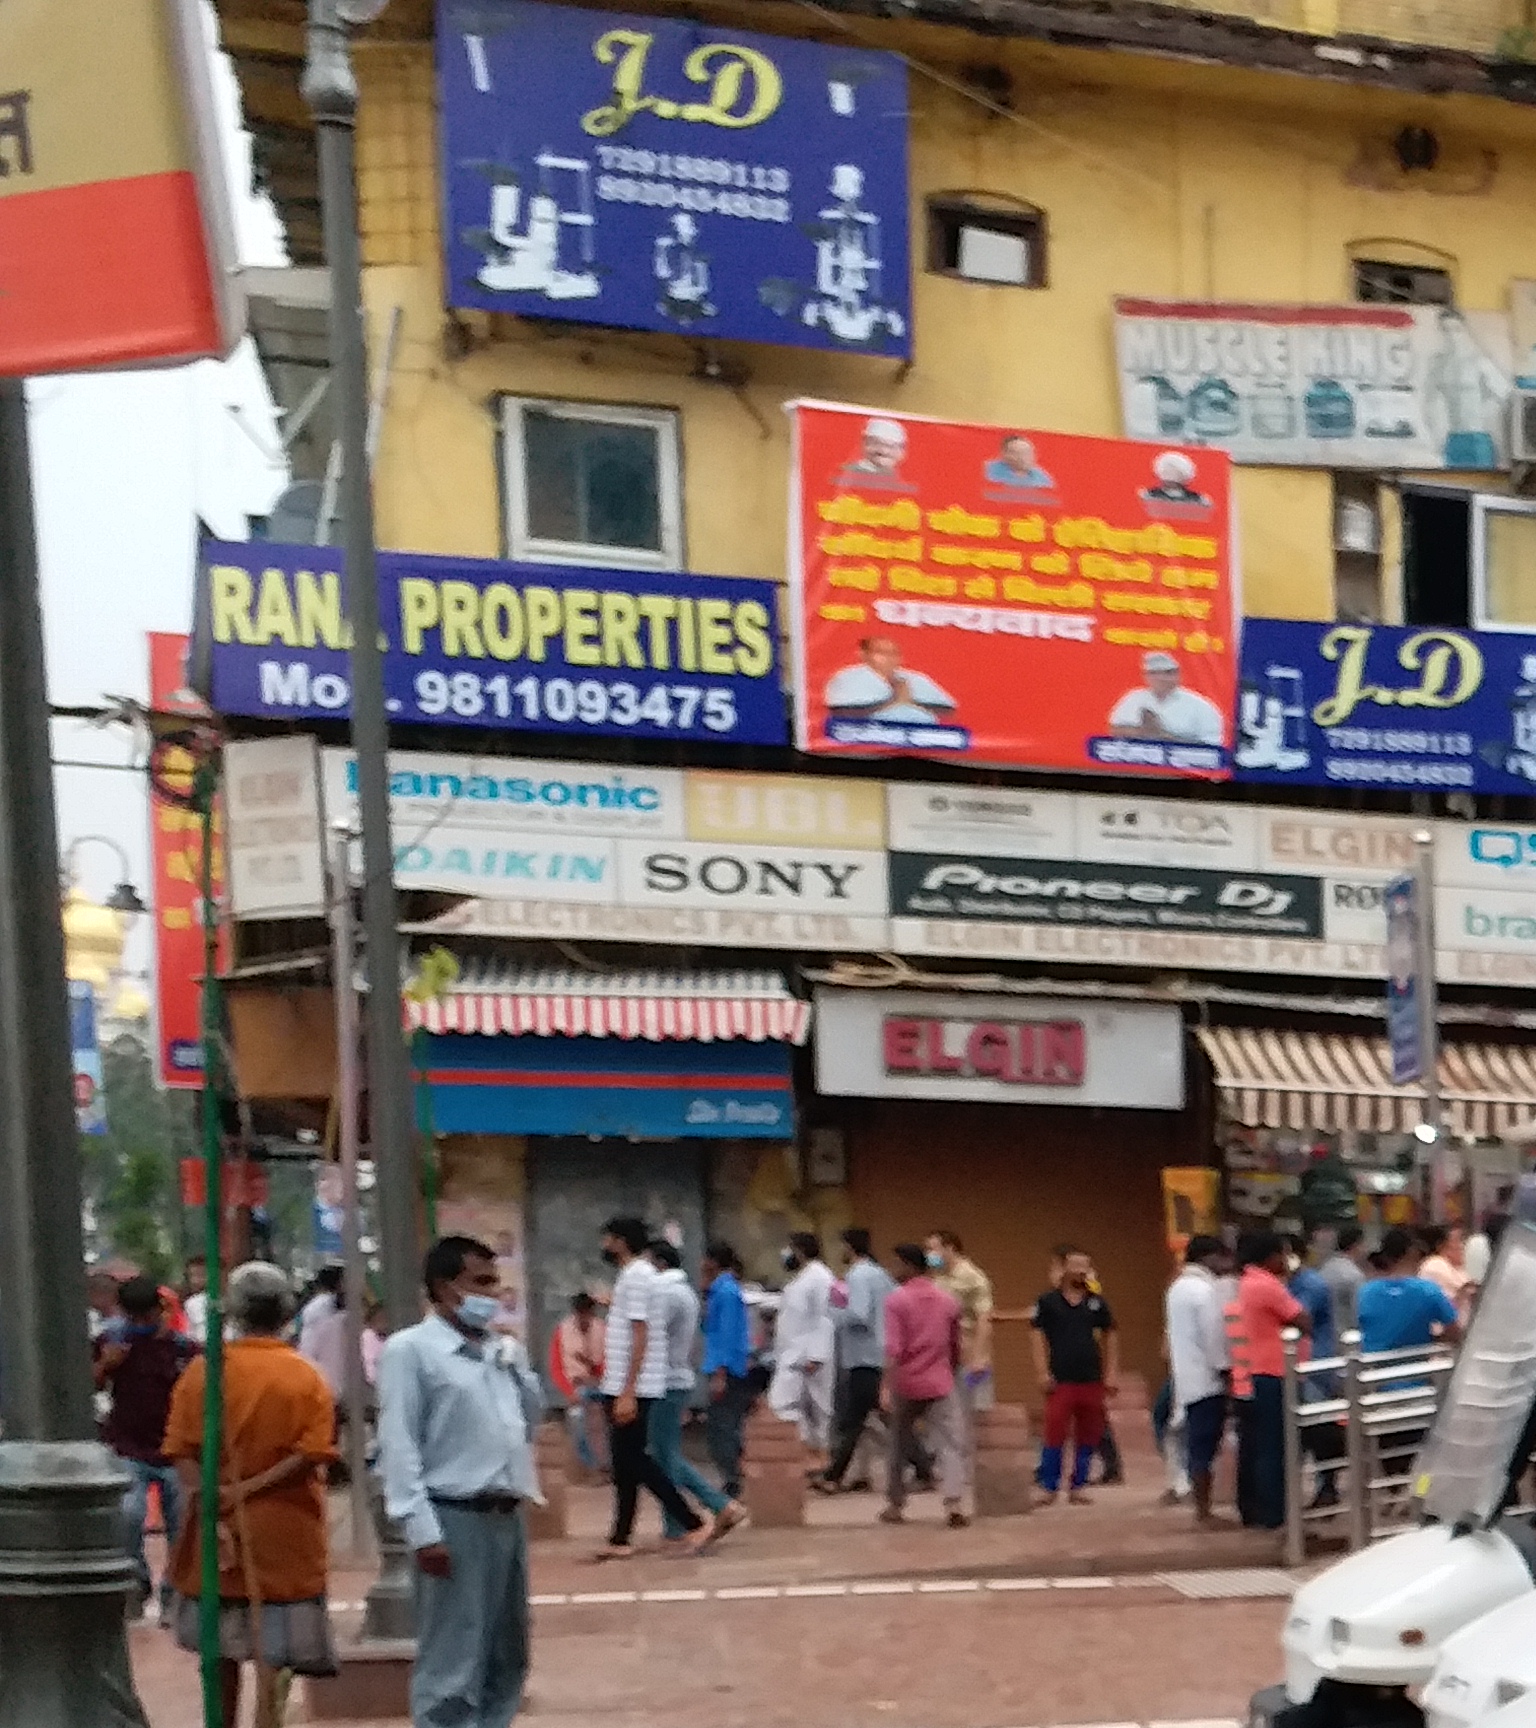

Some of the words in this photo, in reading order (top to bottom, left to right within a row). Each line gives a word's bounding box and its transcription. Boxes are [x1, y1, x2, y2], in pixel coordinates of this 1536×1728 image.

[582, 28, 784, 137] J.D
[400, 577, 774, 678] PROPERTIES
[258, 660, 402, 712] Mo.
[413, 669, 738, 733] 9811093475
[1311, 625, 1485, 727] J.D
[393, 846, 605, 883] DAIKIN
[646, 852, 862, 900] SONY
[921, 863, 1199, 905] Pioneer
[884, 1017, 1086, 1087] ELGIN
